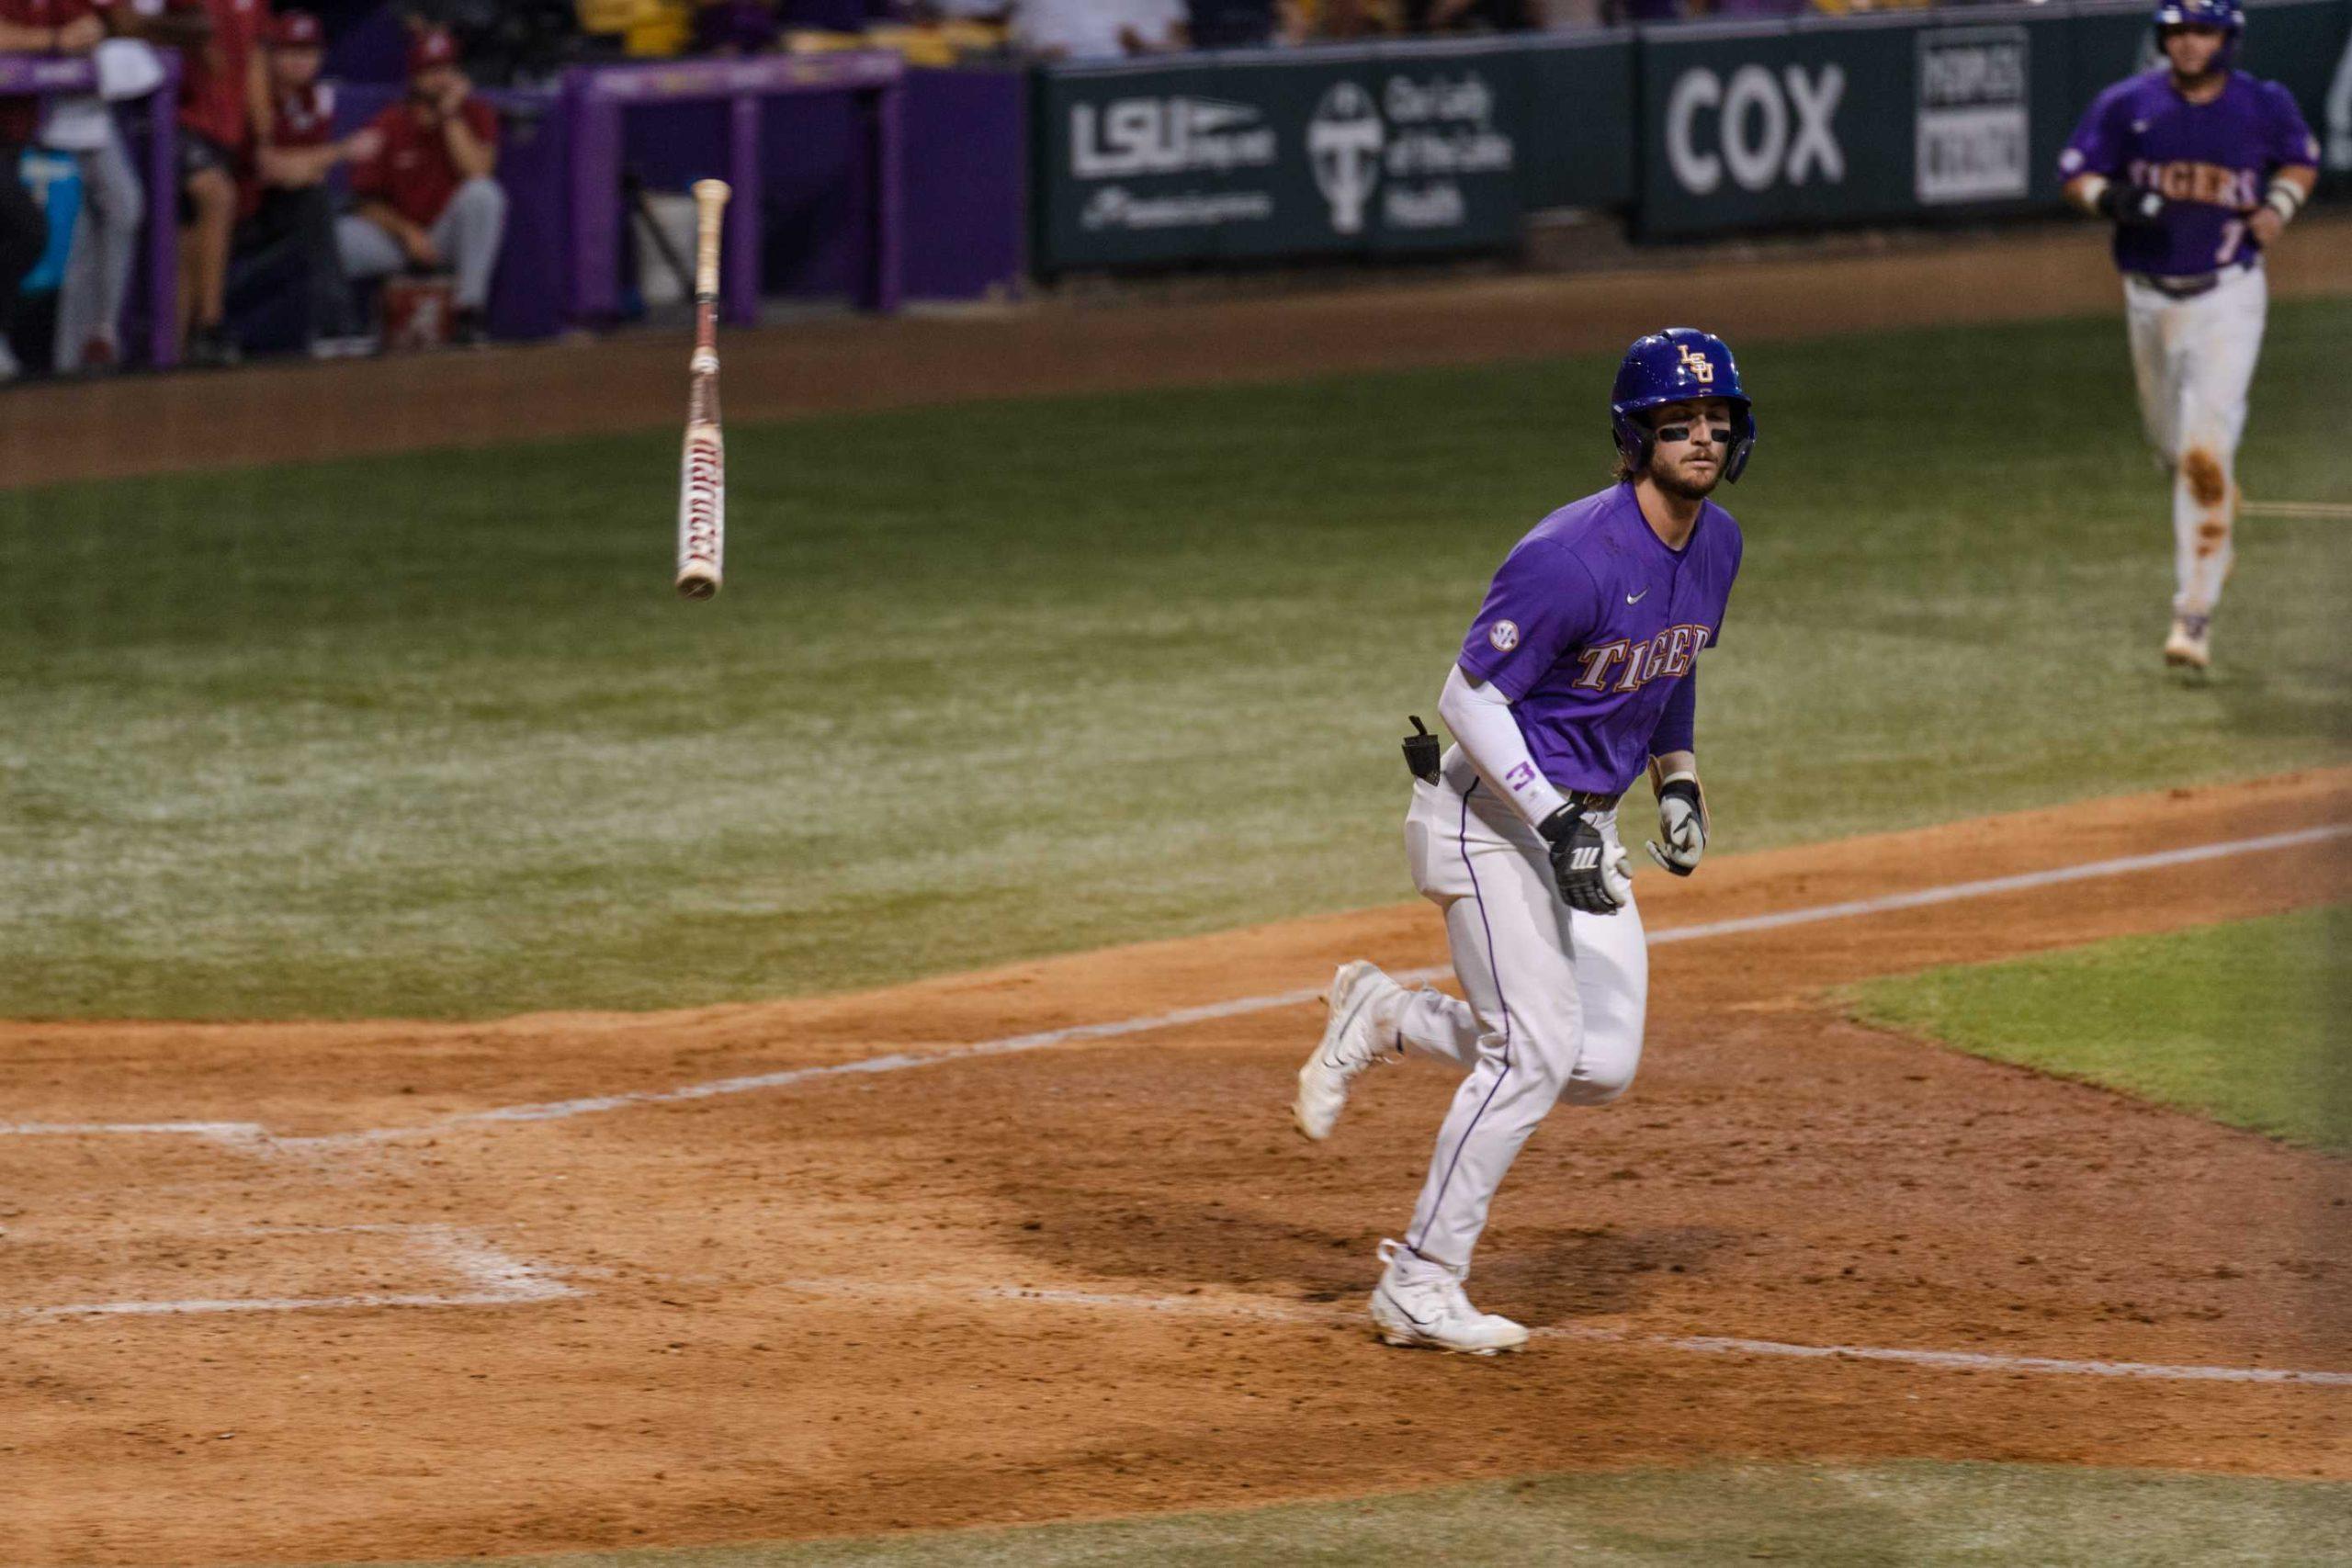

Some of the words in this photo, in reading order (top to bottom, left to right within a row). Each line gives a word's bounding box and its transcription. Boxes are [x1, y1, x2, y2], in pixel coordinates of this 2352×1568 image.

[1071, 96, 1192, 179] LSU
[1667, 64, 1846, 195] COX
[1677, 344, 1713, 383] LSU
[1506, 761, 1536, 792] 3
